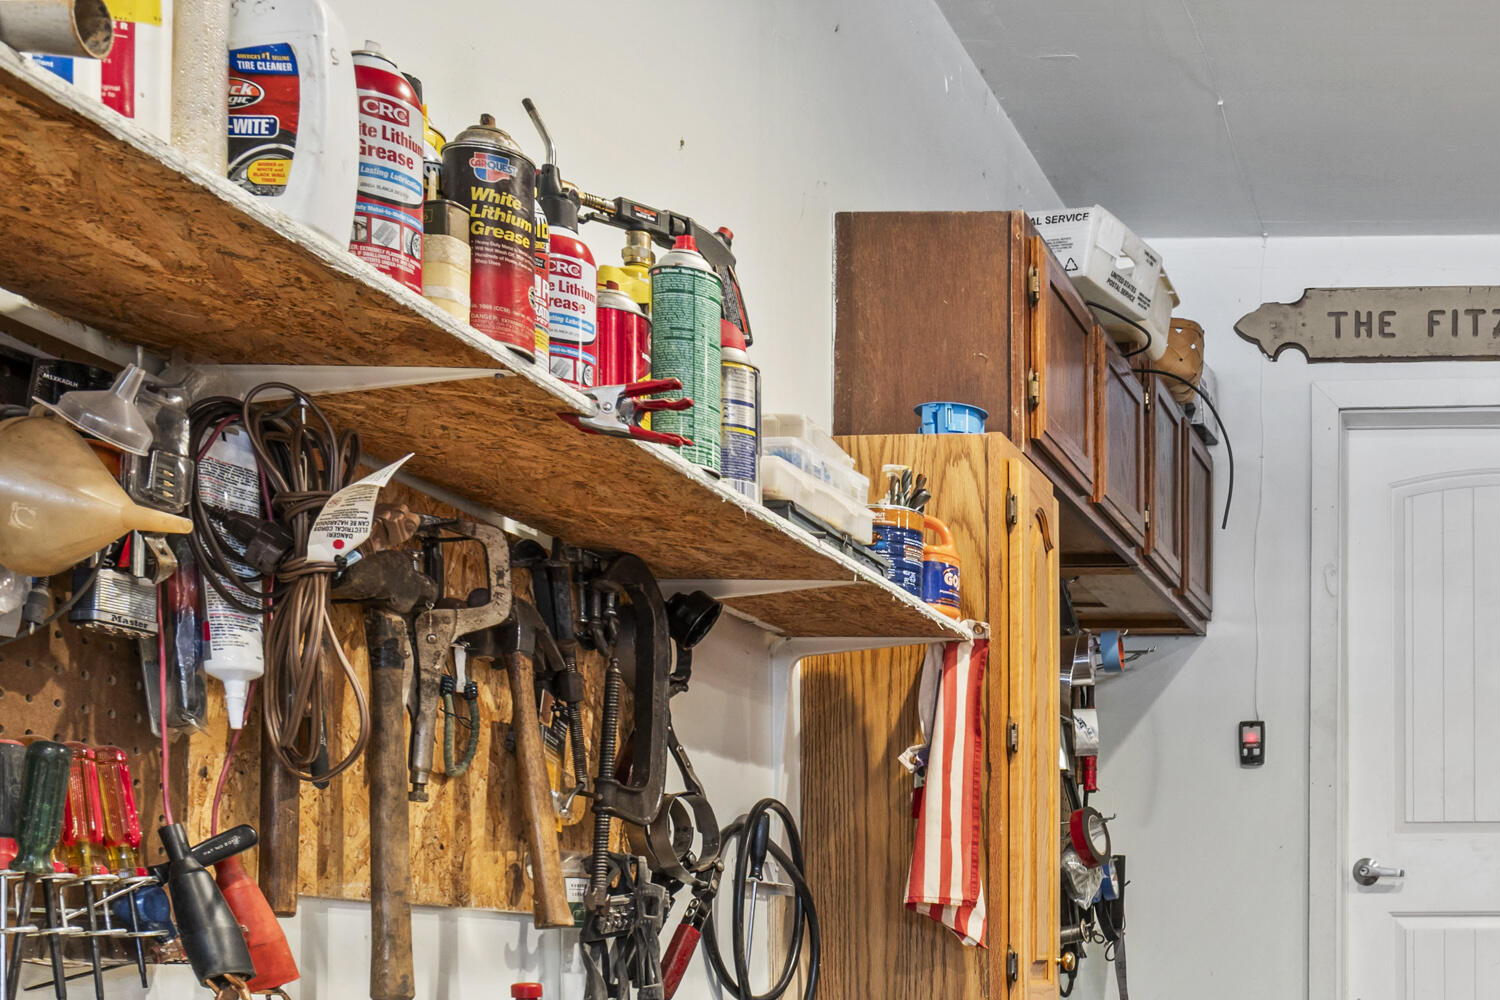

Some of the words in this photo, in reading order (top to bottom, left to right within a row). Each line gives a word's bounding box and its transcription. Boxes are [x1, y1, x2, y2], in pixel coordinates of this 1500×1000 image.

[236, 60, 255, 70] TIRE
[257, 61, 293, 71] CLEANER
[261, 51, 270, 60] #1
[362, 98, 407, 123] CRC
[381, 125, 423, 158] Lithium
[359, 138, 414, 170] Grease
[469, 157, 518, 177] CARQUEST
[470, 186, 522, 211] White
[470, 203, 533, 234] Lithium
[1045, 212, 1089, 225] SERVICE
[470, 220, 531, 249] Grease
[549, 260, 580, 276] CRC
[558, 280, 596, 304] Lithium
[1106, 277, 1123, 296] POSTAL
[1120, 286, 1136, 303] SERVICE
[1110, 270, 1126, 289] UNITED
[1122, 279, 1137, 294] STATES
[1327, 310, 1397, 339] THE
[326, 532, 354, 540] DANGER!
[334, 525, 369, 534] ELECTRICAL
[111, 614, 149, 629] Master
